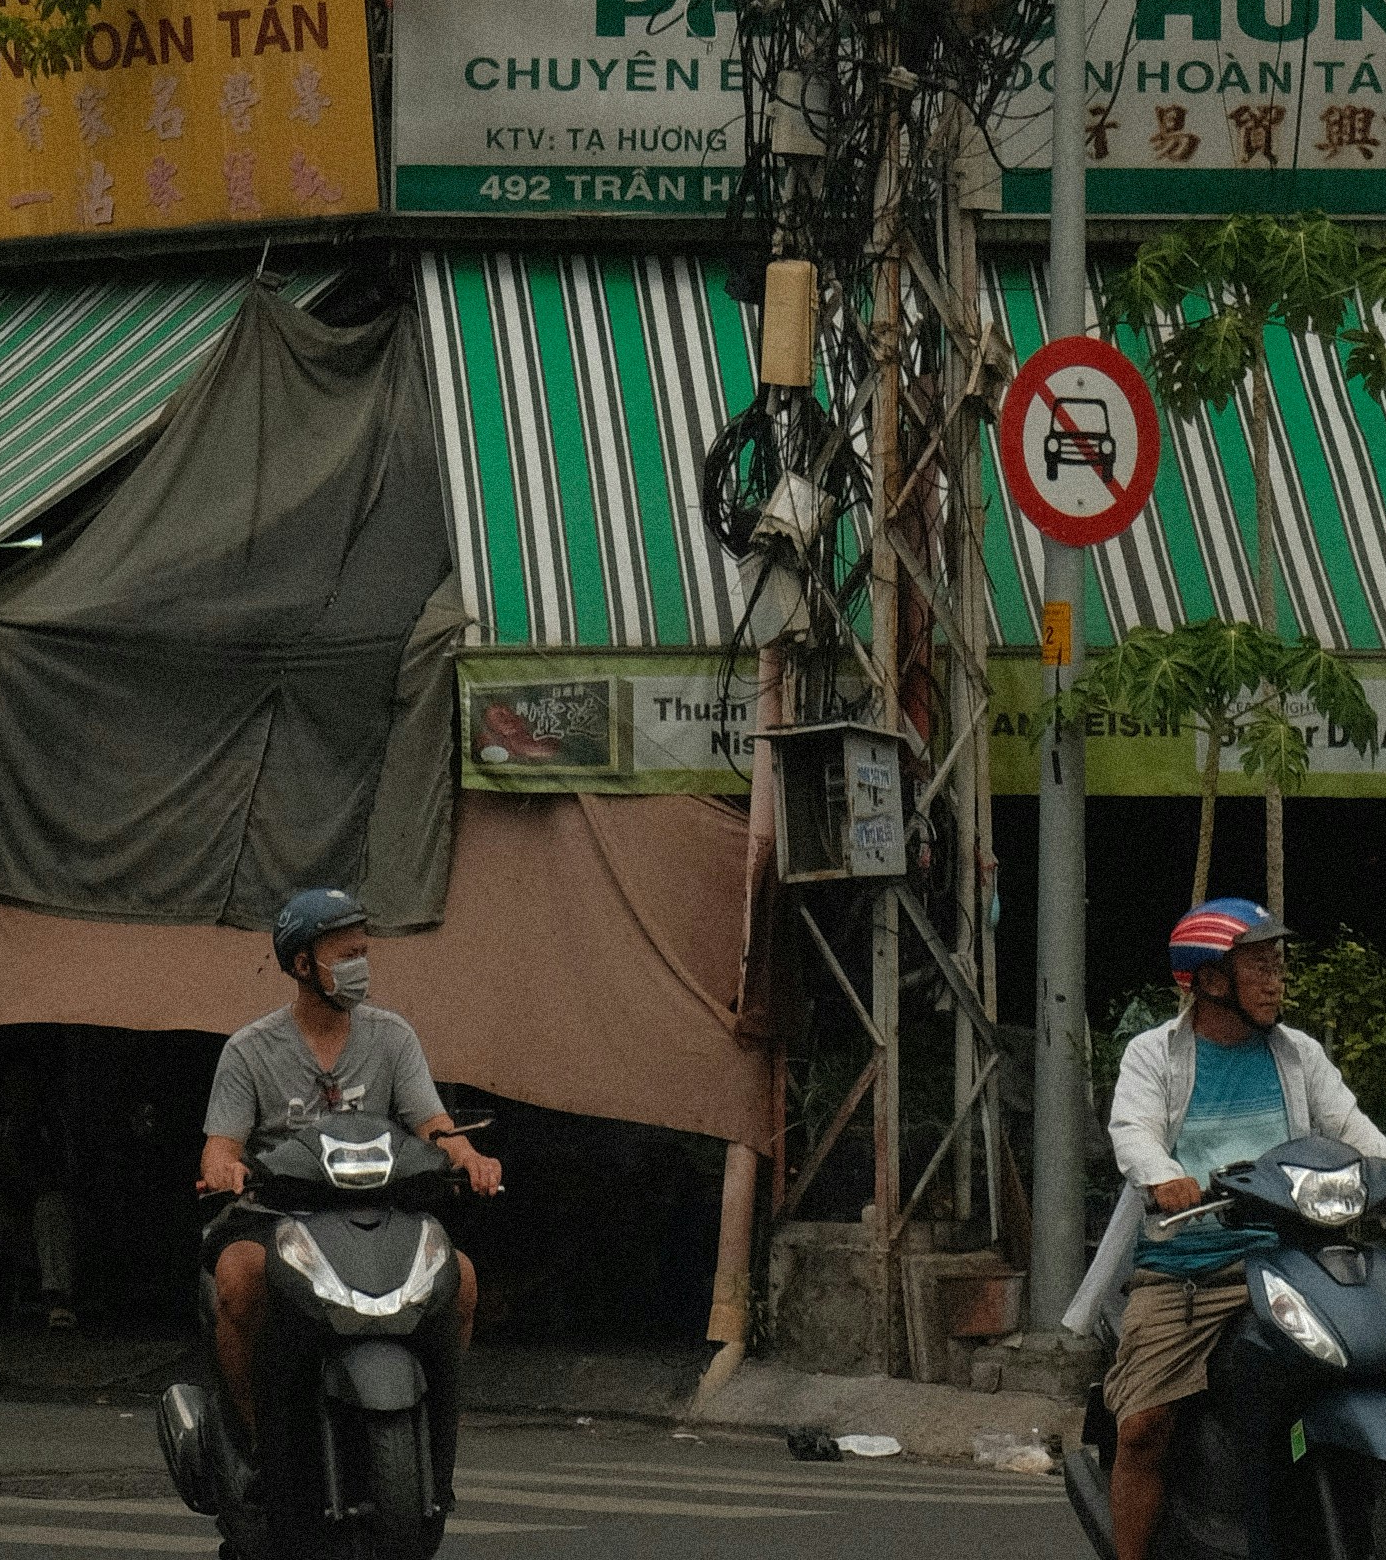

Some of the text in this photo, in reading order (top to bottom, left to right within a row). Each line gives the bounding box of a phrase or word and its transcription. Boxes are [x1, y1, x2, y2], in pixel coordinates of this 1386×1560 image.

[465, 50, 699, 91] CHUYÊN
[1138, 53, 1292, 93] HOÀN
[486, 125, 728, 156] KTV: TẠ HƯƠNG
[479, 174, 551, 201] 492
[565, 167, 687, 201] TRẦN
[1084, 711, 1181, 737] EISHI
[712, 731, 755, 755] Nis
